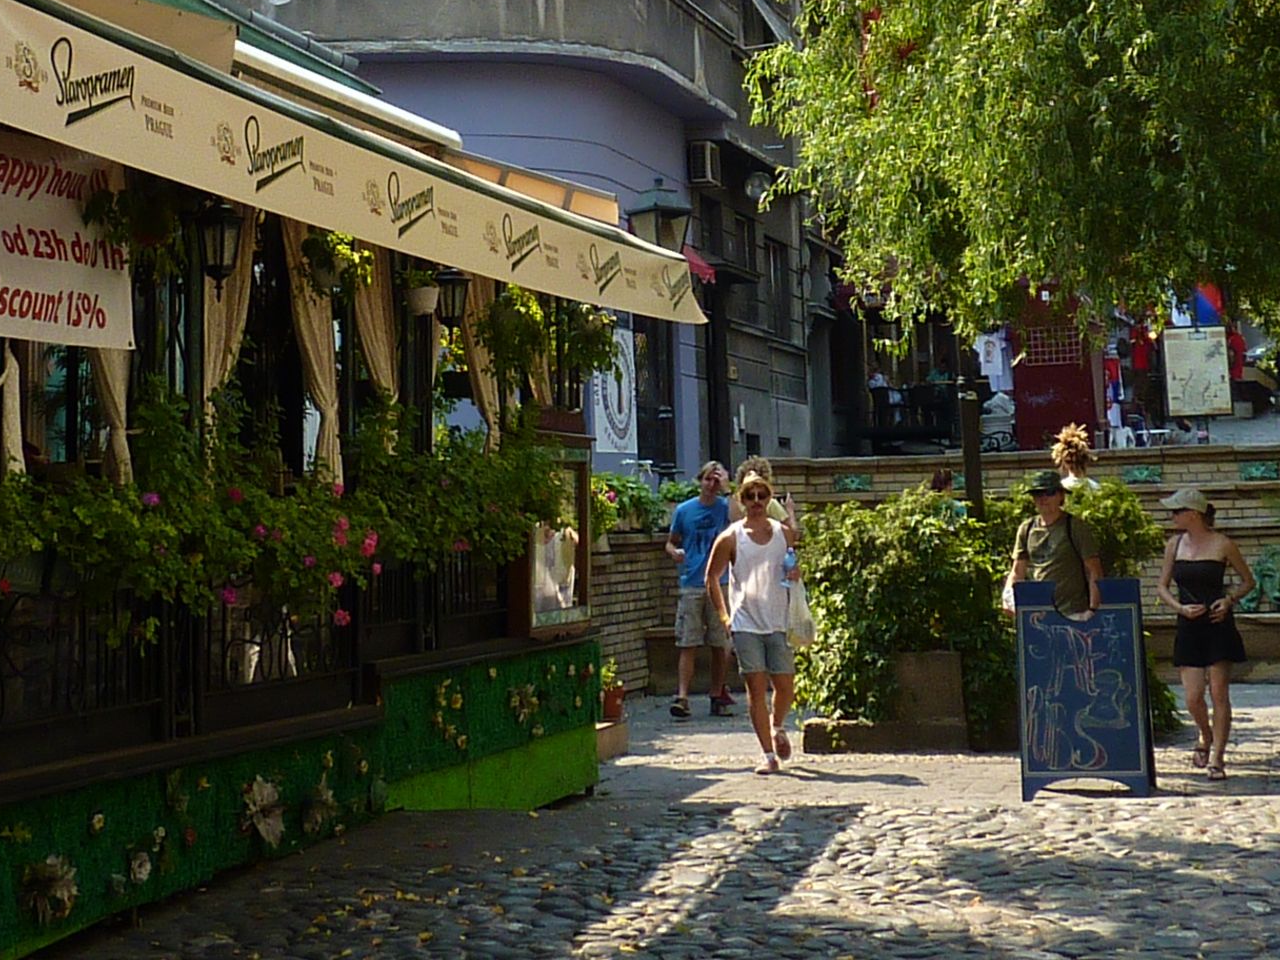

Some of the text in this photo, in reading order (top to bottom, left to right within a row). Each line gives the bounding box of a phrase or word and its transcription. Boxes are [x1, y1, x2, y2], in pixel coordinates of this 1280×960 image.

[51, 37, 136, 127] Staropramen
[46, 156, 87, 201] hour
[1, 223, 29, 256] od
[27, 228, 69, 262] 23h
[67, 290, 107, 329] 15%
